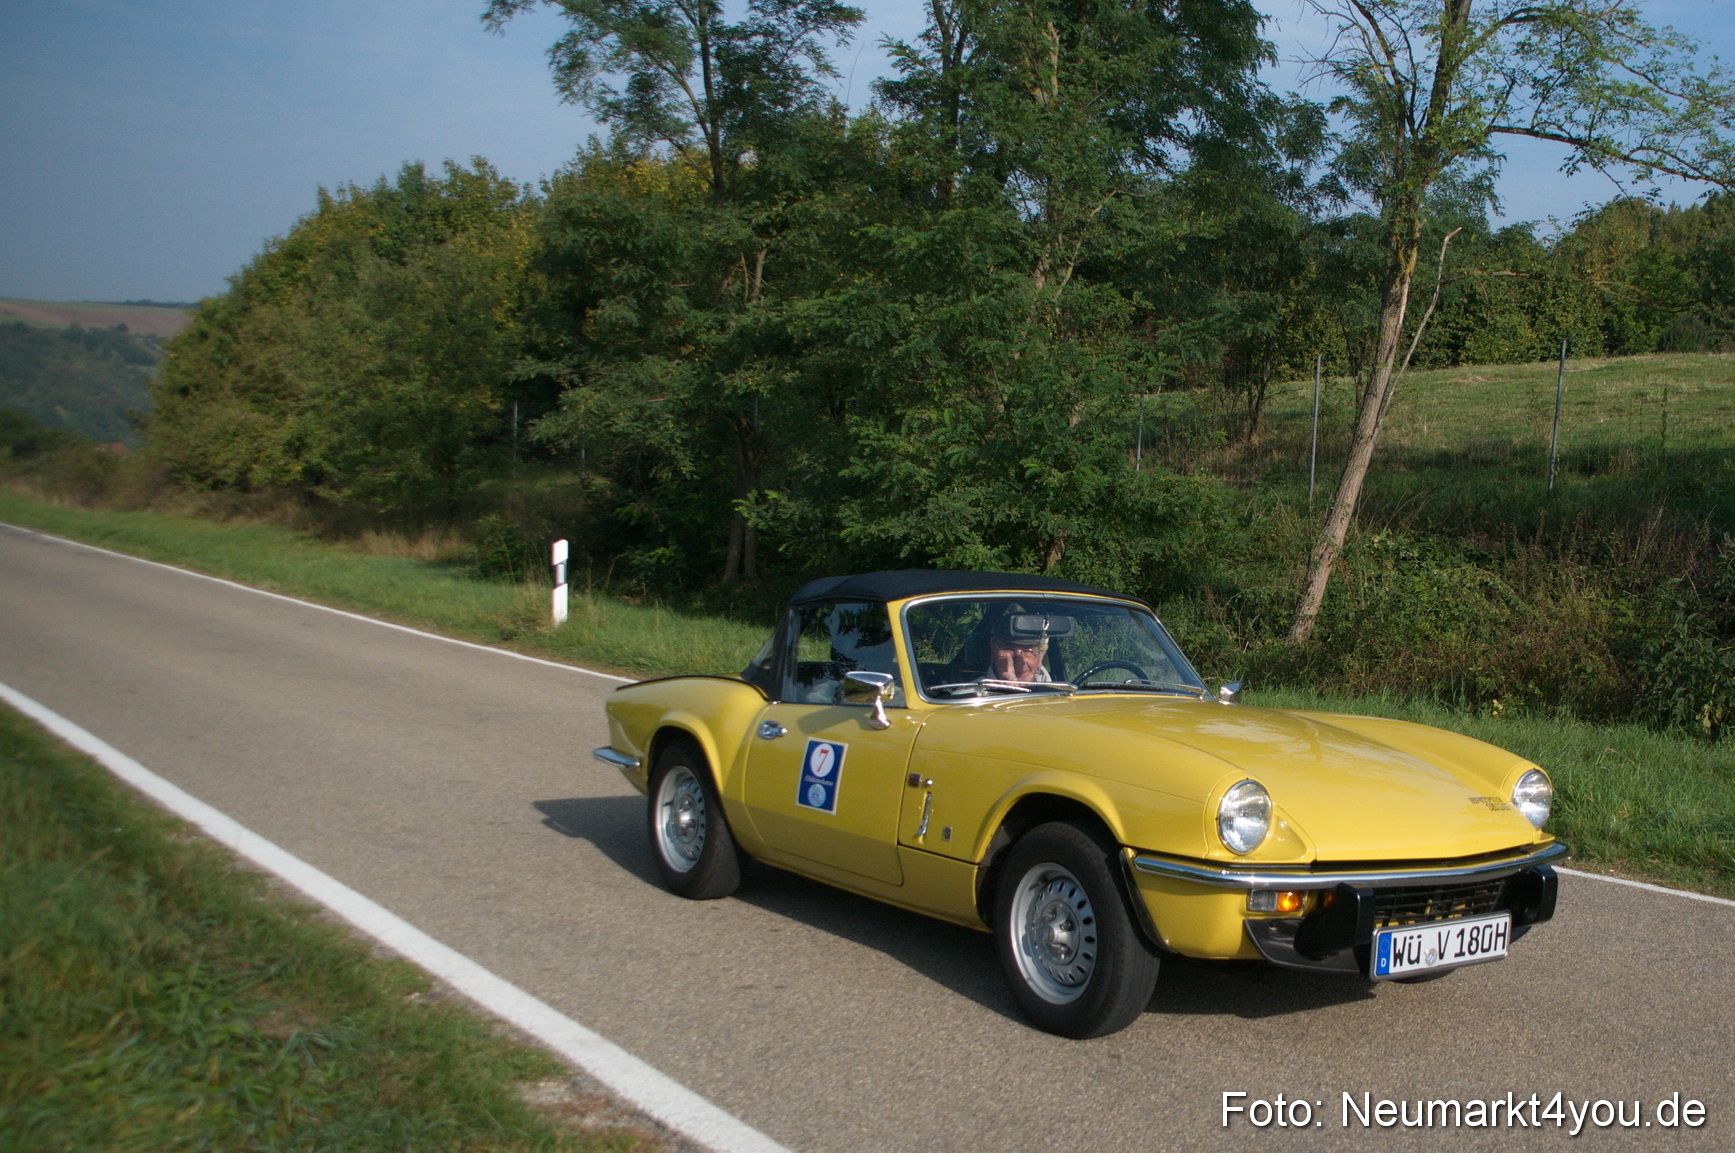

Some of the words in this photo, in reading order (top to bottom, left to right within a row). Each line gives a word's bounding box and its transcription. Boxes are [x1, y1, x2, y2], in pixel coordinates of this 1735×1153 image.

[817, 749, 829, 772] 7
[1392, 934, 1422, 968] WÜ
[1438, 929, 1451, 960] V
[1454, 921, 1508, 958] 180H
[1381, 957, 1387, 968] D
